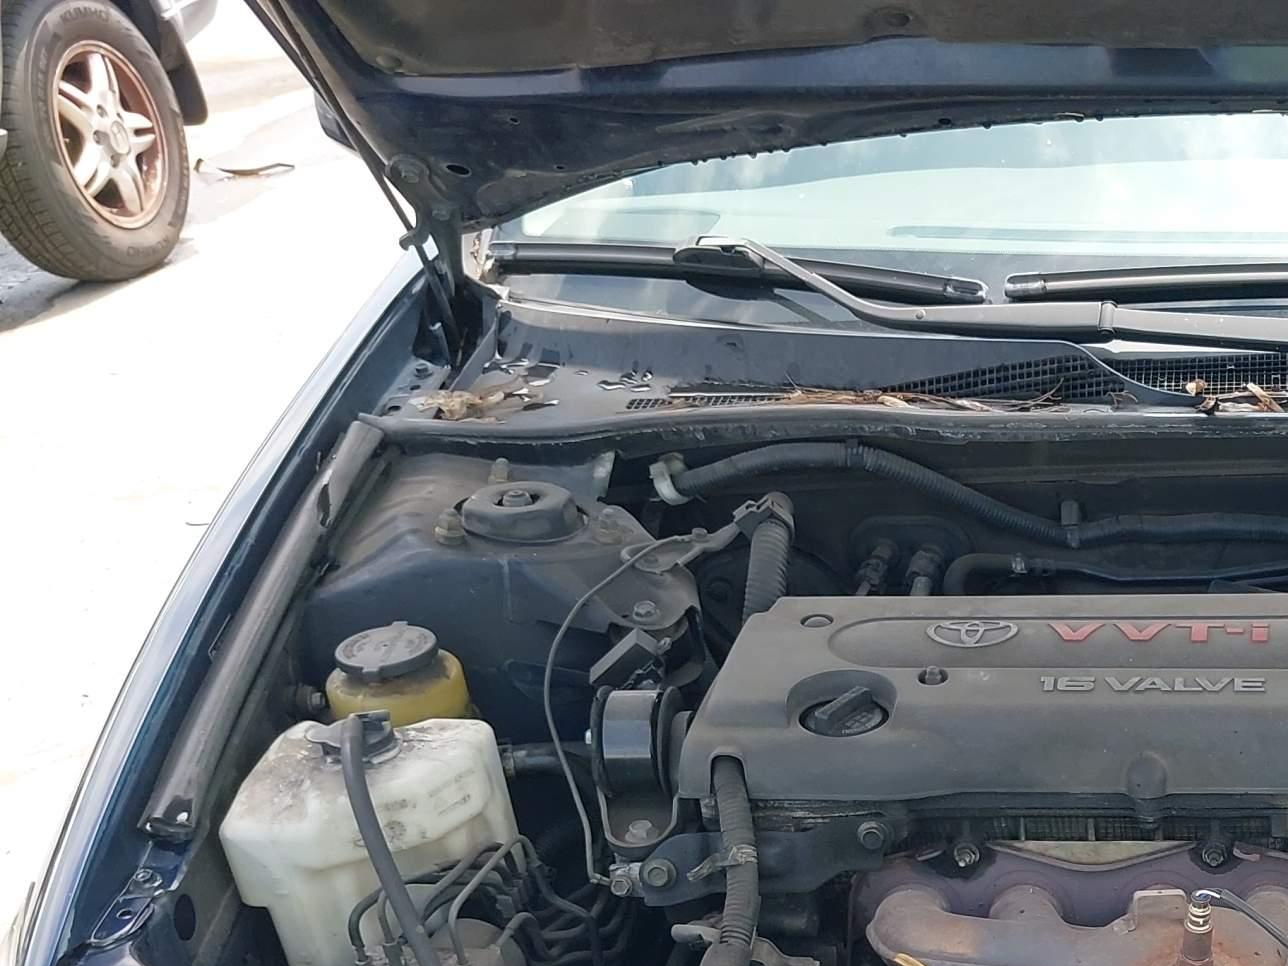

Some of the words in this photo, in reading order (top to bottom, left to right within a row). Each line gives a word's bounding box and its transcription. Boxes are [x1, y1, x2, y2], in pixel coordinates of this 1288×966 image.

[60, 7, 110, 21] KUMHO
[1048, 623, 1268, 642] VVT-i
[1040, 676, 1096, 691] 16
[1104, 676, 1267, 692] VALVE
